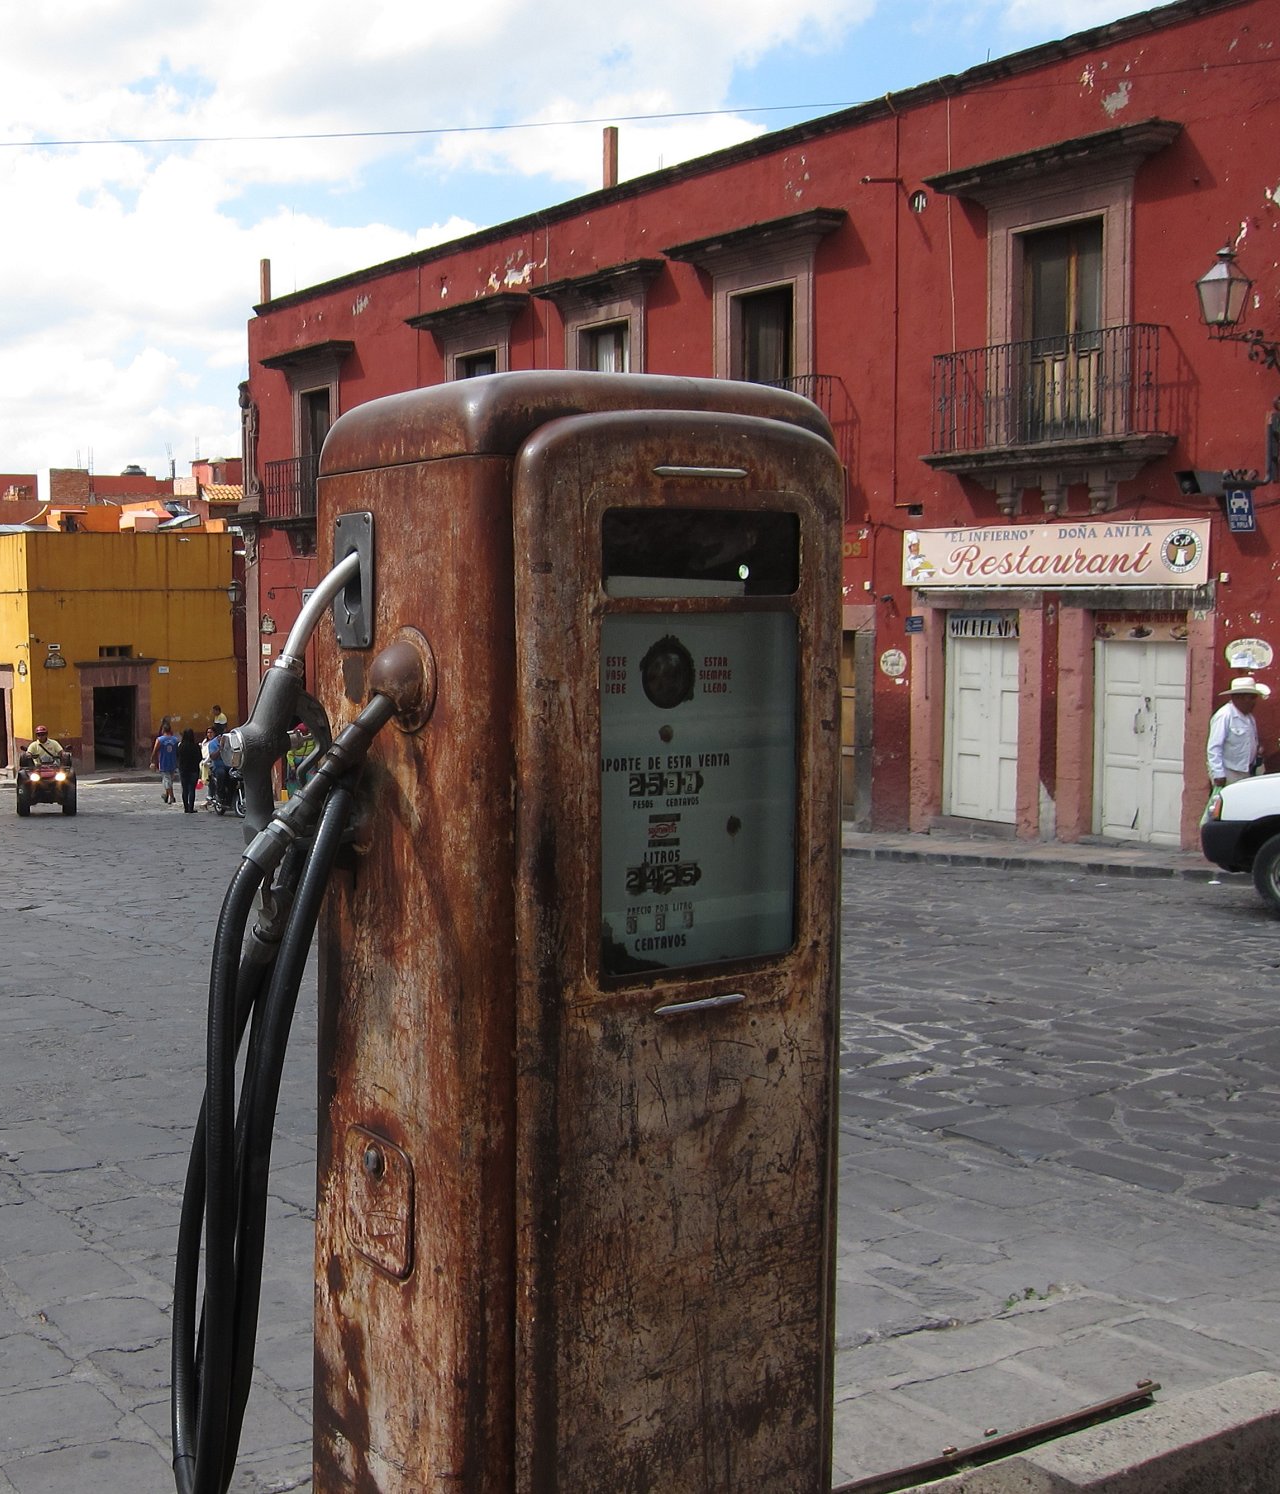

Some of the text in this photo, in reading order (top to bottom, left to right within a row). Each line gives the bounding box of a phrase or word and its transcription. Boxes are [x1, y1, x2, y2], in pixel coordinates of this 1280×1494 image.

[1058, 525, 1097, 539] DOÑA
[1104, 524, 1152, 537] ANITA
[942, 542, 1153, 576] Restaurant
[606, 656, 627, 667] ESTE
[704, 656, 728, 667] ESTAR
[605, 670, 627, 681] VASO
[699, 670, 732, 681] SIEMPRE
[605, 683, 626, 694] DEBE
[648, 756, 661, 770] DE
[667, 755, 692, 769] ESTA
[699, 753, 730, 767] VENTA
[632, 796, 700, 809] PESOS CENTAVOS
[643, 849, 680, 864] LITROS
[627, 901, 693, 915] PRECIO POR LITRO
[635, 934, 687, 952] CENTAVOS
